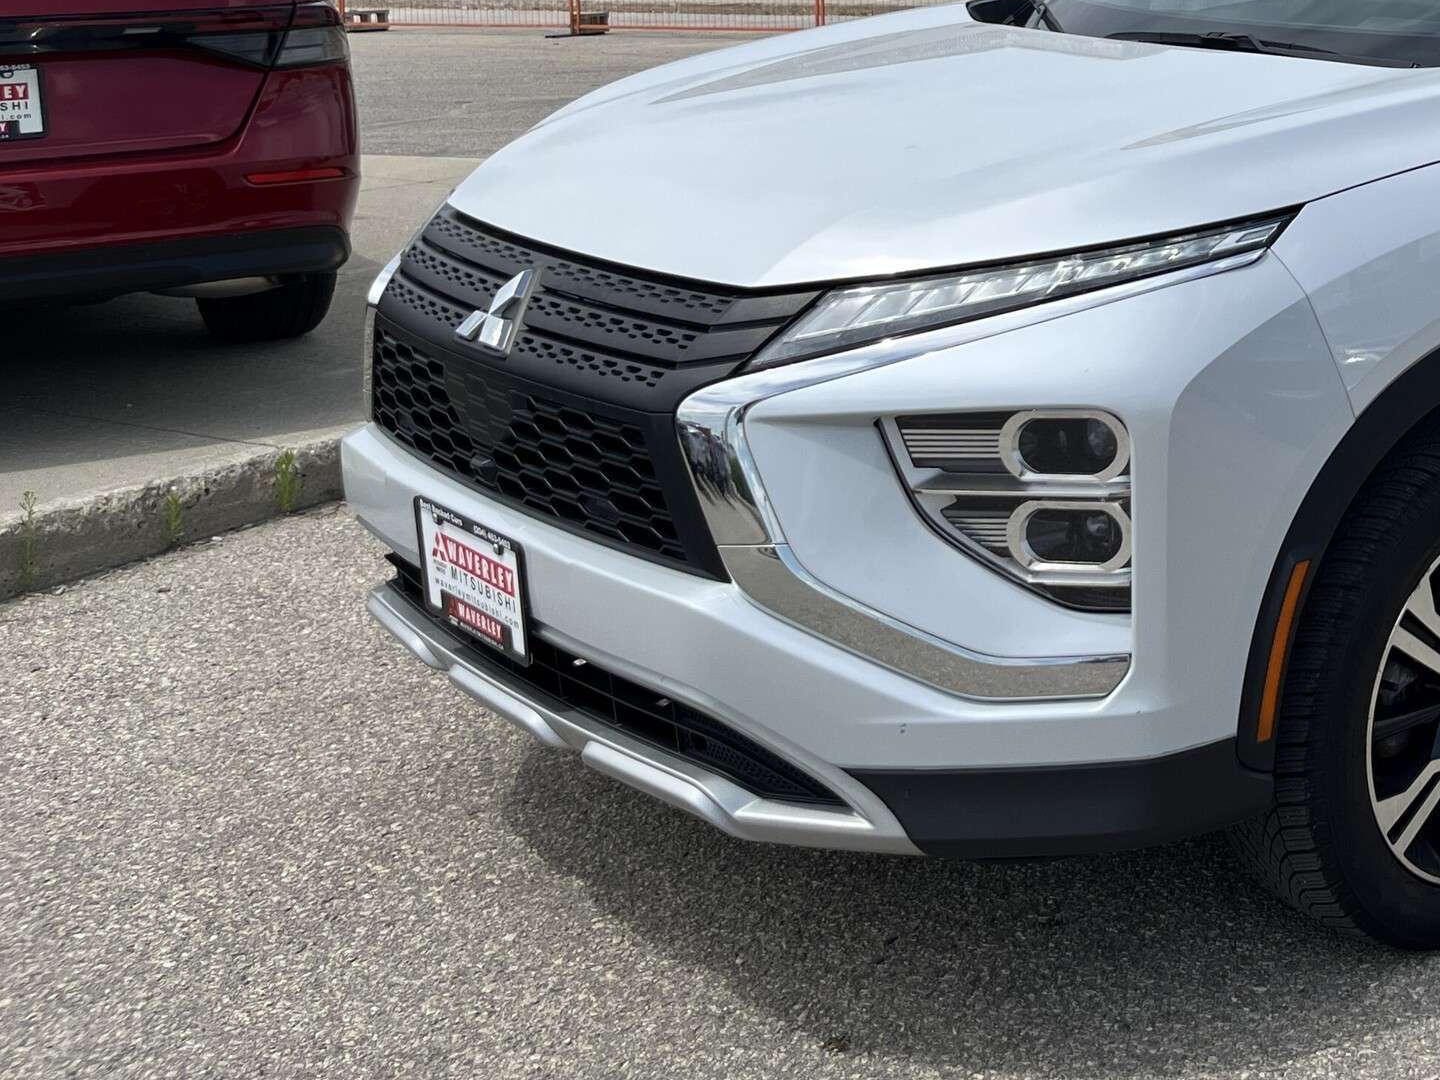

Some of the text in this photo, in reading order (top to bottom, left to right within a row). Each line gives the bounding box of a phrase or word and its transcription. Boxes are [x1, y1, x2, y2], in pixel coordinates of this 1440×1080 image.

[446, 538, 513, 594] WAVERLEY
[450, 565, 516, 613] MITSUBISHI
[457, 602, 502, 639] WAVERLEY
